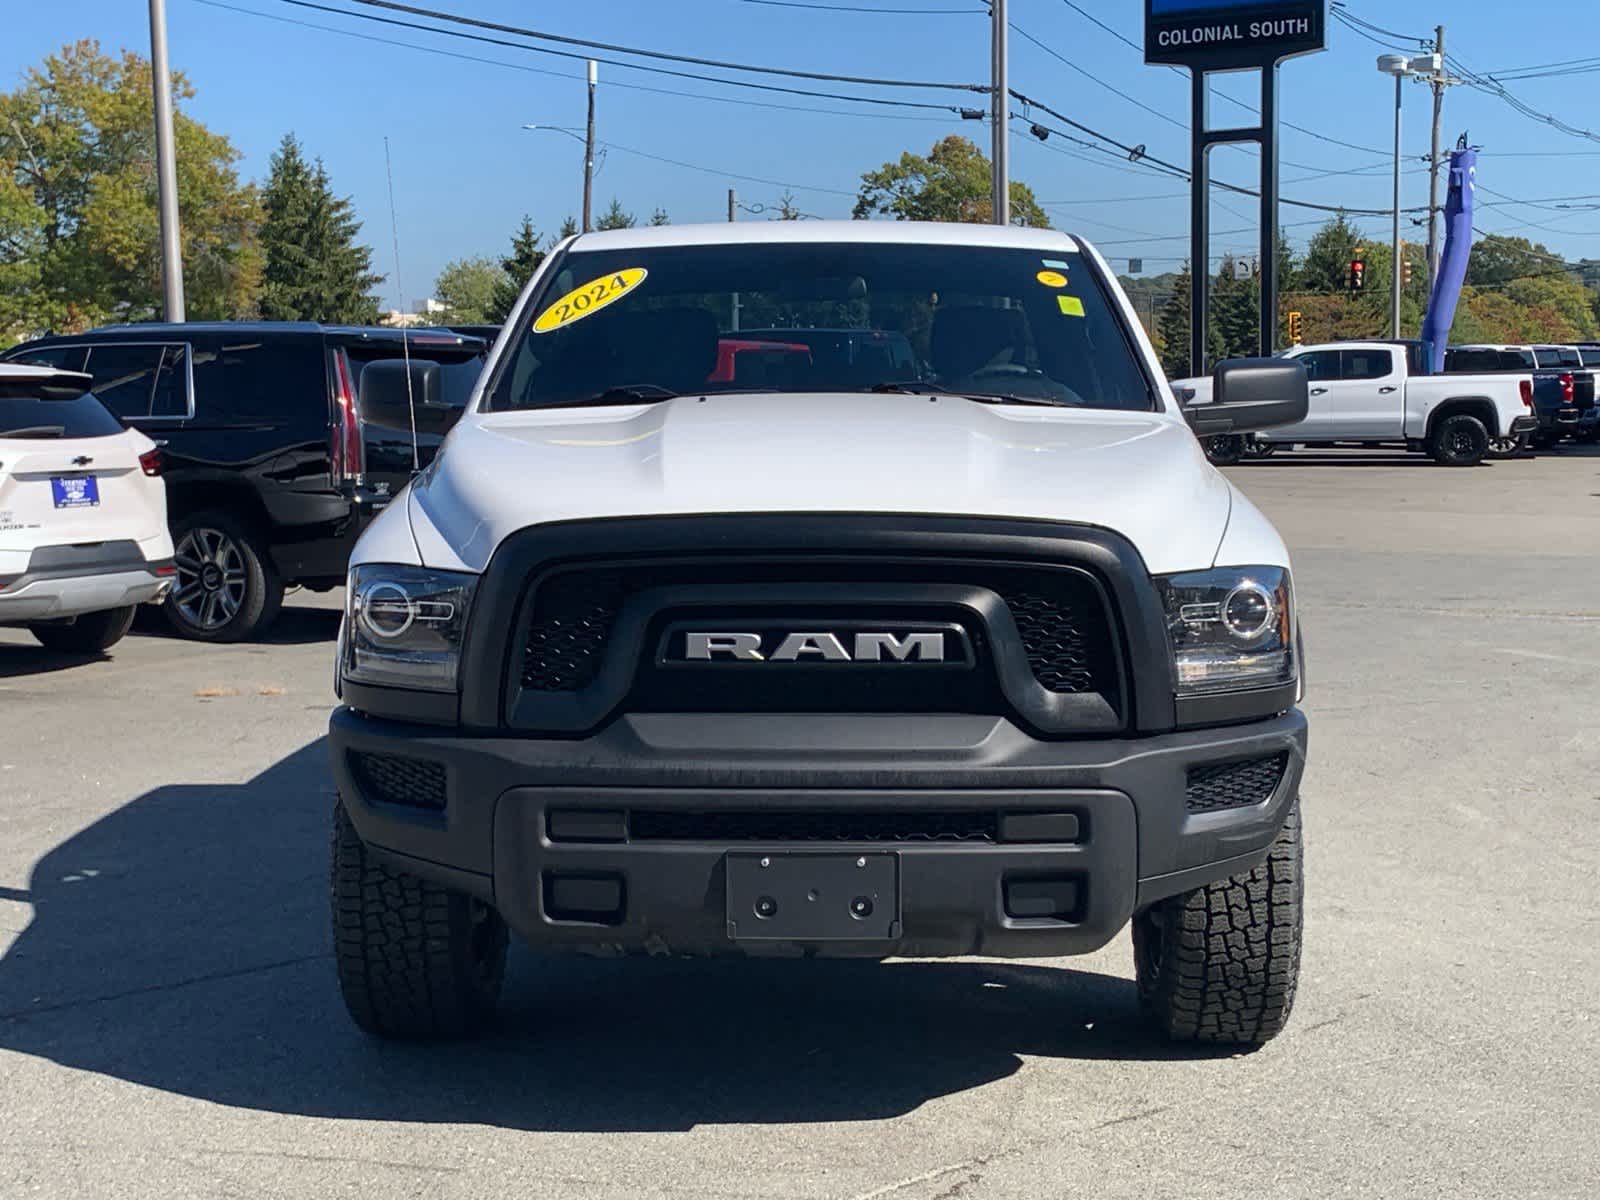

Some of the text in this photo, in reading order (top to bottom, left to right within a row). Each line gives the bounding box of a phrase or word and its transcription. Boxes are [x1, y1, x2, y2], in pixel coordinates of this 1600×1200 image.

[1158, 18, 1308, 46] COLONIAL SOUTH
[555, 275, 629, 323] 2024
[686, 632, 944, 661] RAM
